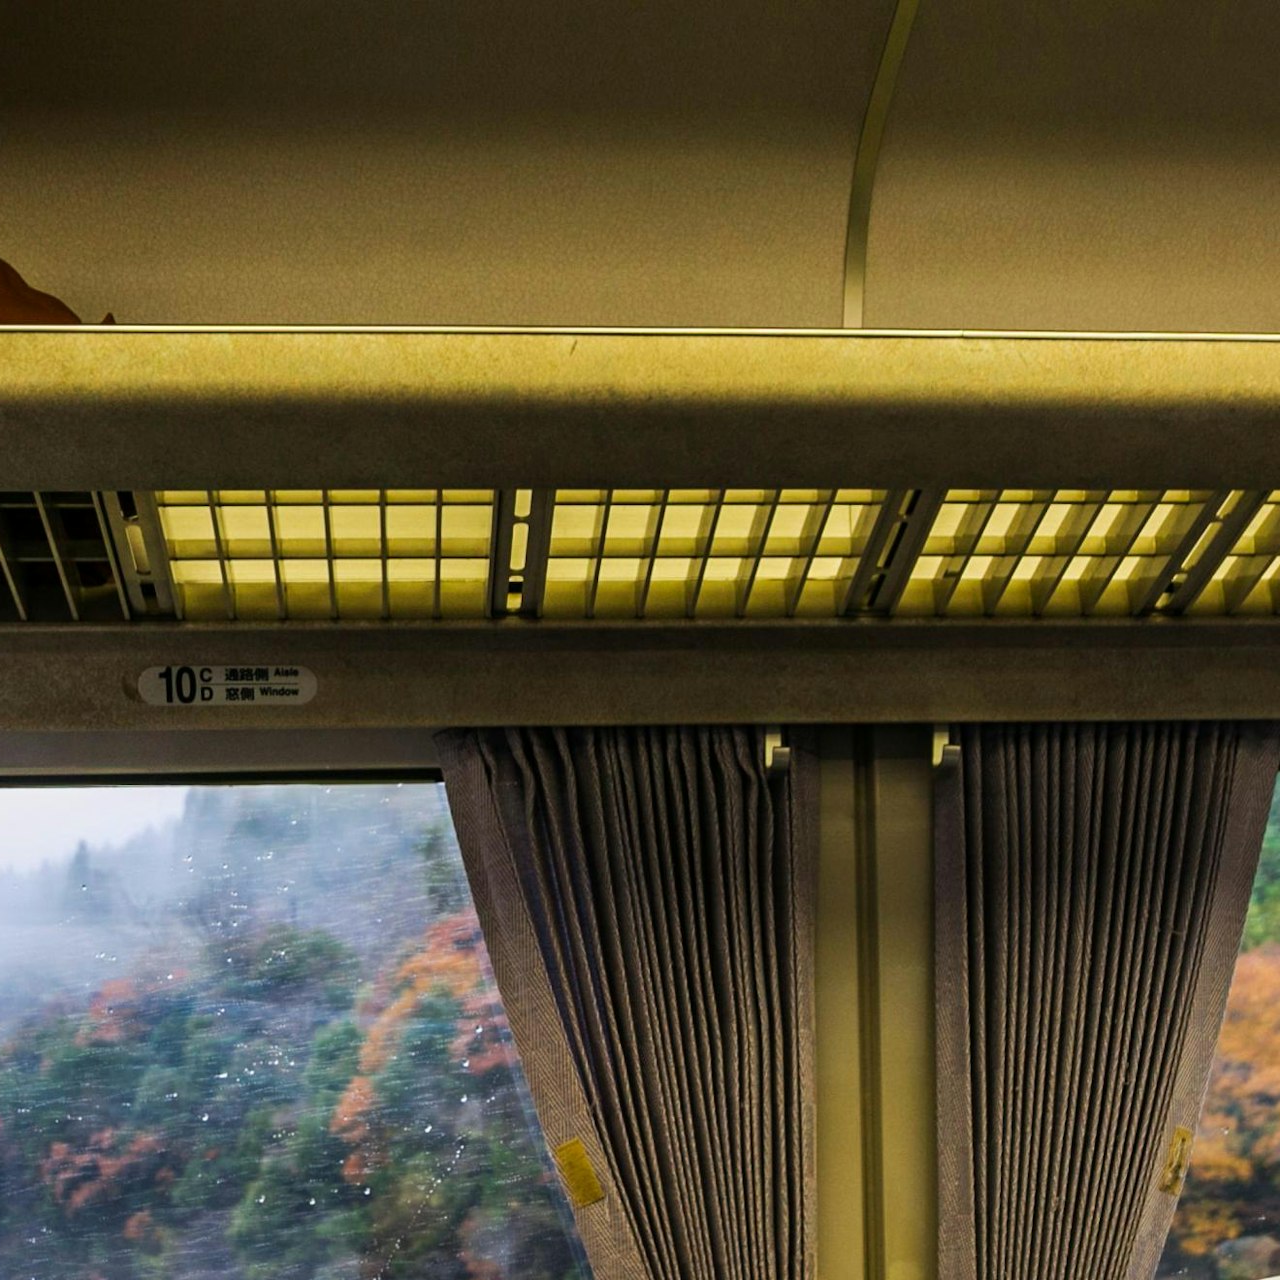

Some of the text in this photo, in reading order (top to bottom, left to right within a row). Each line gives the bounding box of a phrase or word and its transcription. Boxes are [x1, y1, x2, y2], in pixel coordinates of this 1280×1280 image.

[200, 668, 298, 682] C 通路側 Aisle
[158, 666, 197, 703] 10
[201, 687, 214, 701] D
[260, 687, 299, 696] Window
